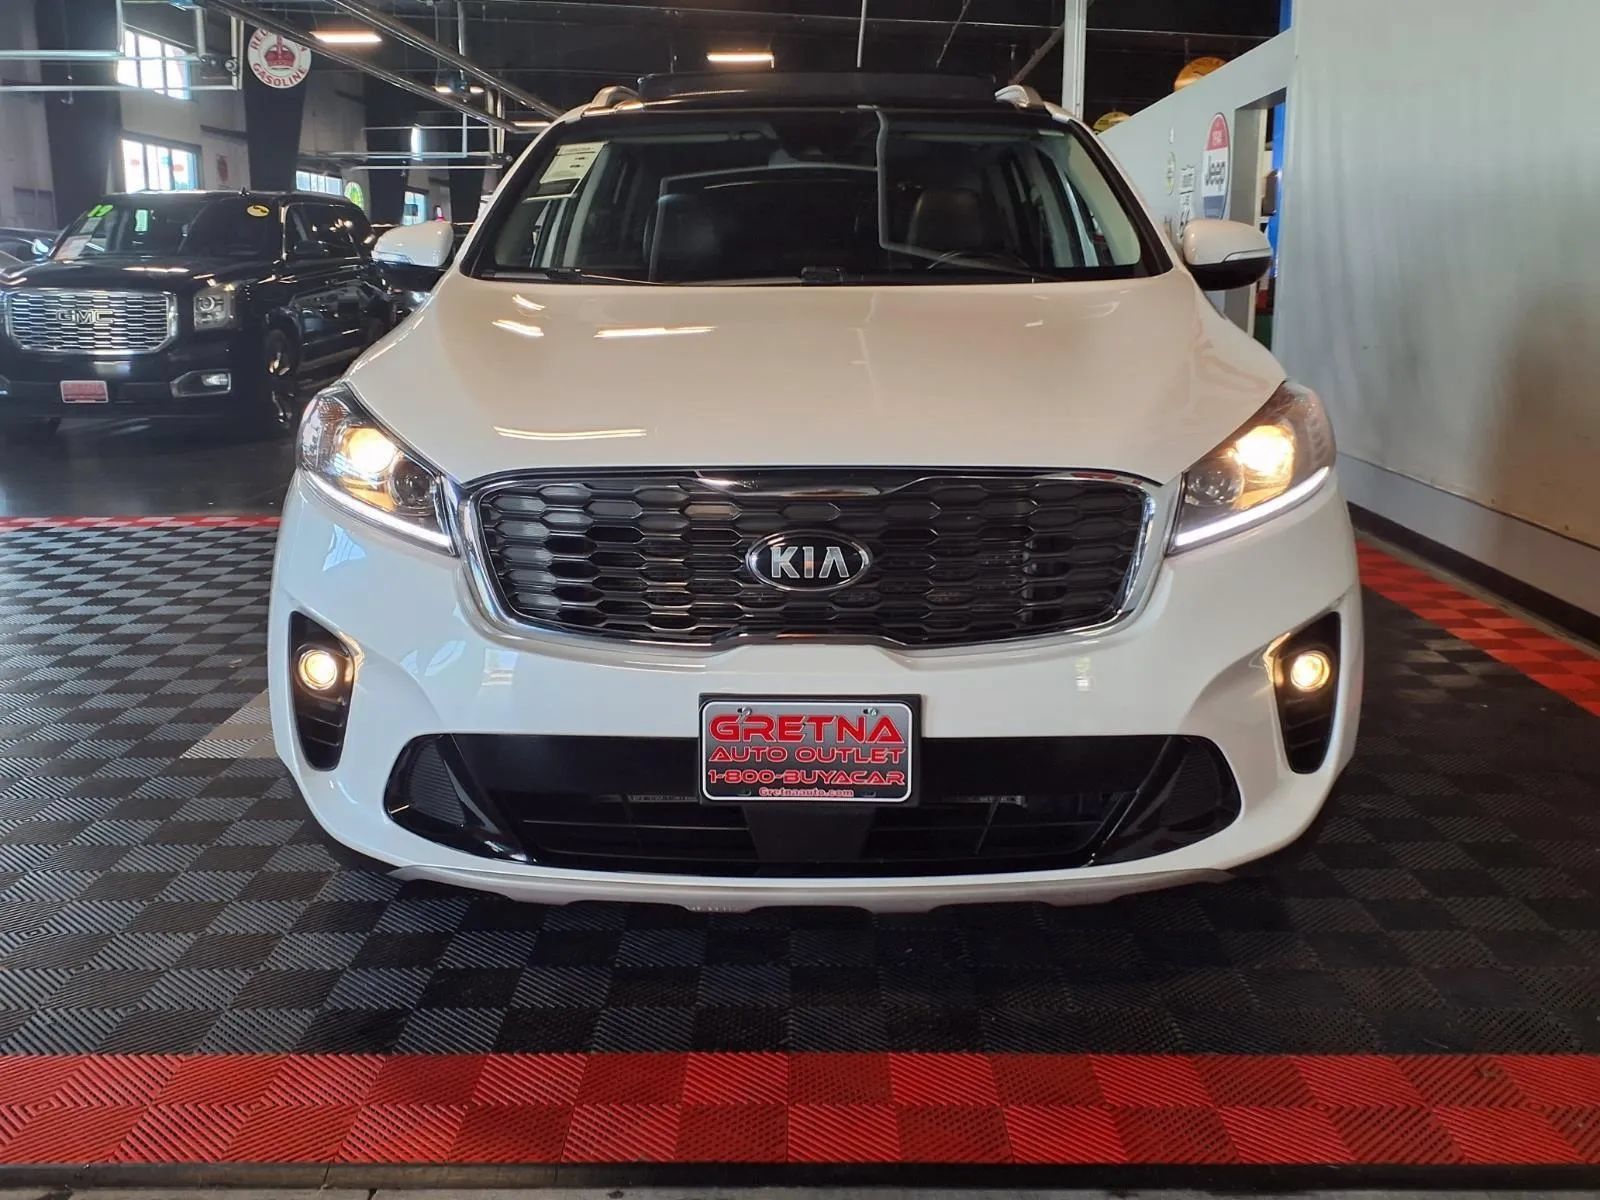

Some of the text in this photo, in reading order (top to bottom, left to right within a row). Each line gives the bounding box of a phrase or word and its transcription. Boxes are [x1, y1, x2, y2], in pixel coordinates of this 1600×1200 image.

[252, 63, 308, 87] GASOLINE
[56, 308, 114, 324] GMC
[770, 546, 850, 579] KIA
[709, 714, 905, 743] GRETNA
[708, 746, 906, 764] AUTO OUTLET
[708, 769, 905, 785] 1-800-BUYACAR
[758, 786, 854, 798] Gretnaauto.com
